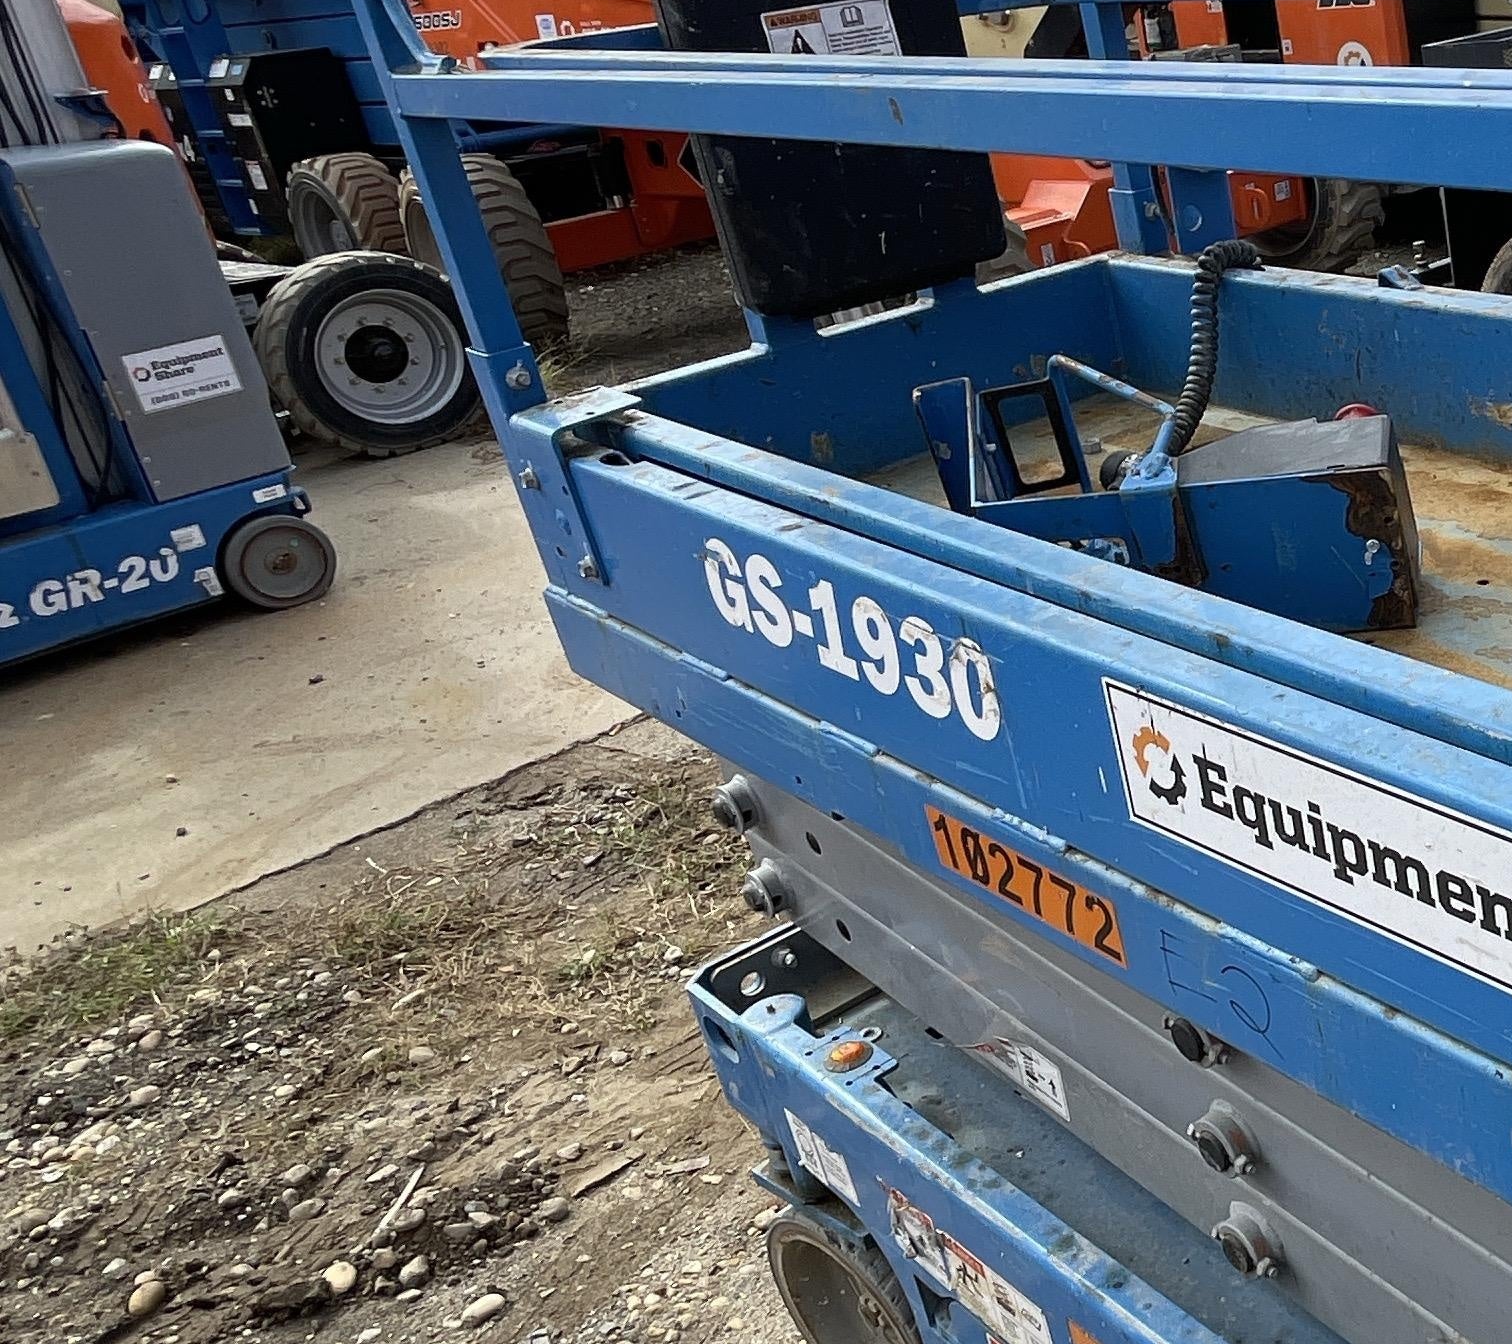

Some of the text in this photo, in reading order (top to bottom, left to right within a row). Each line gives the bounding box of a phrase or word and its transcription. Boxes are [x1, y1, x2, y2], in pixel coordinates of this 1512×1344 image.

[29, 547, 180, 617] GR-20
[703, 537, 1001, 742] GS-1930
[934, 814, 1124, 962] 102772
